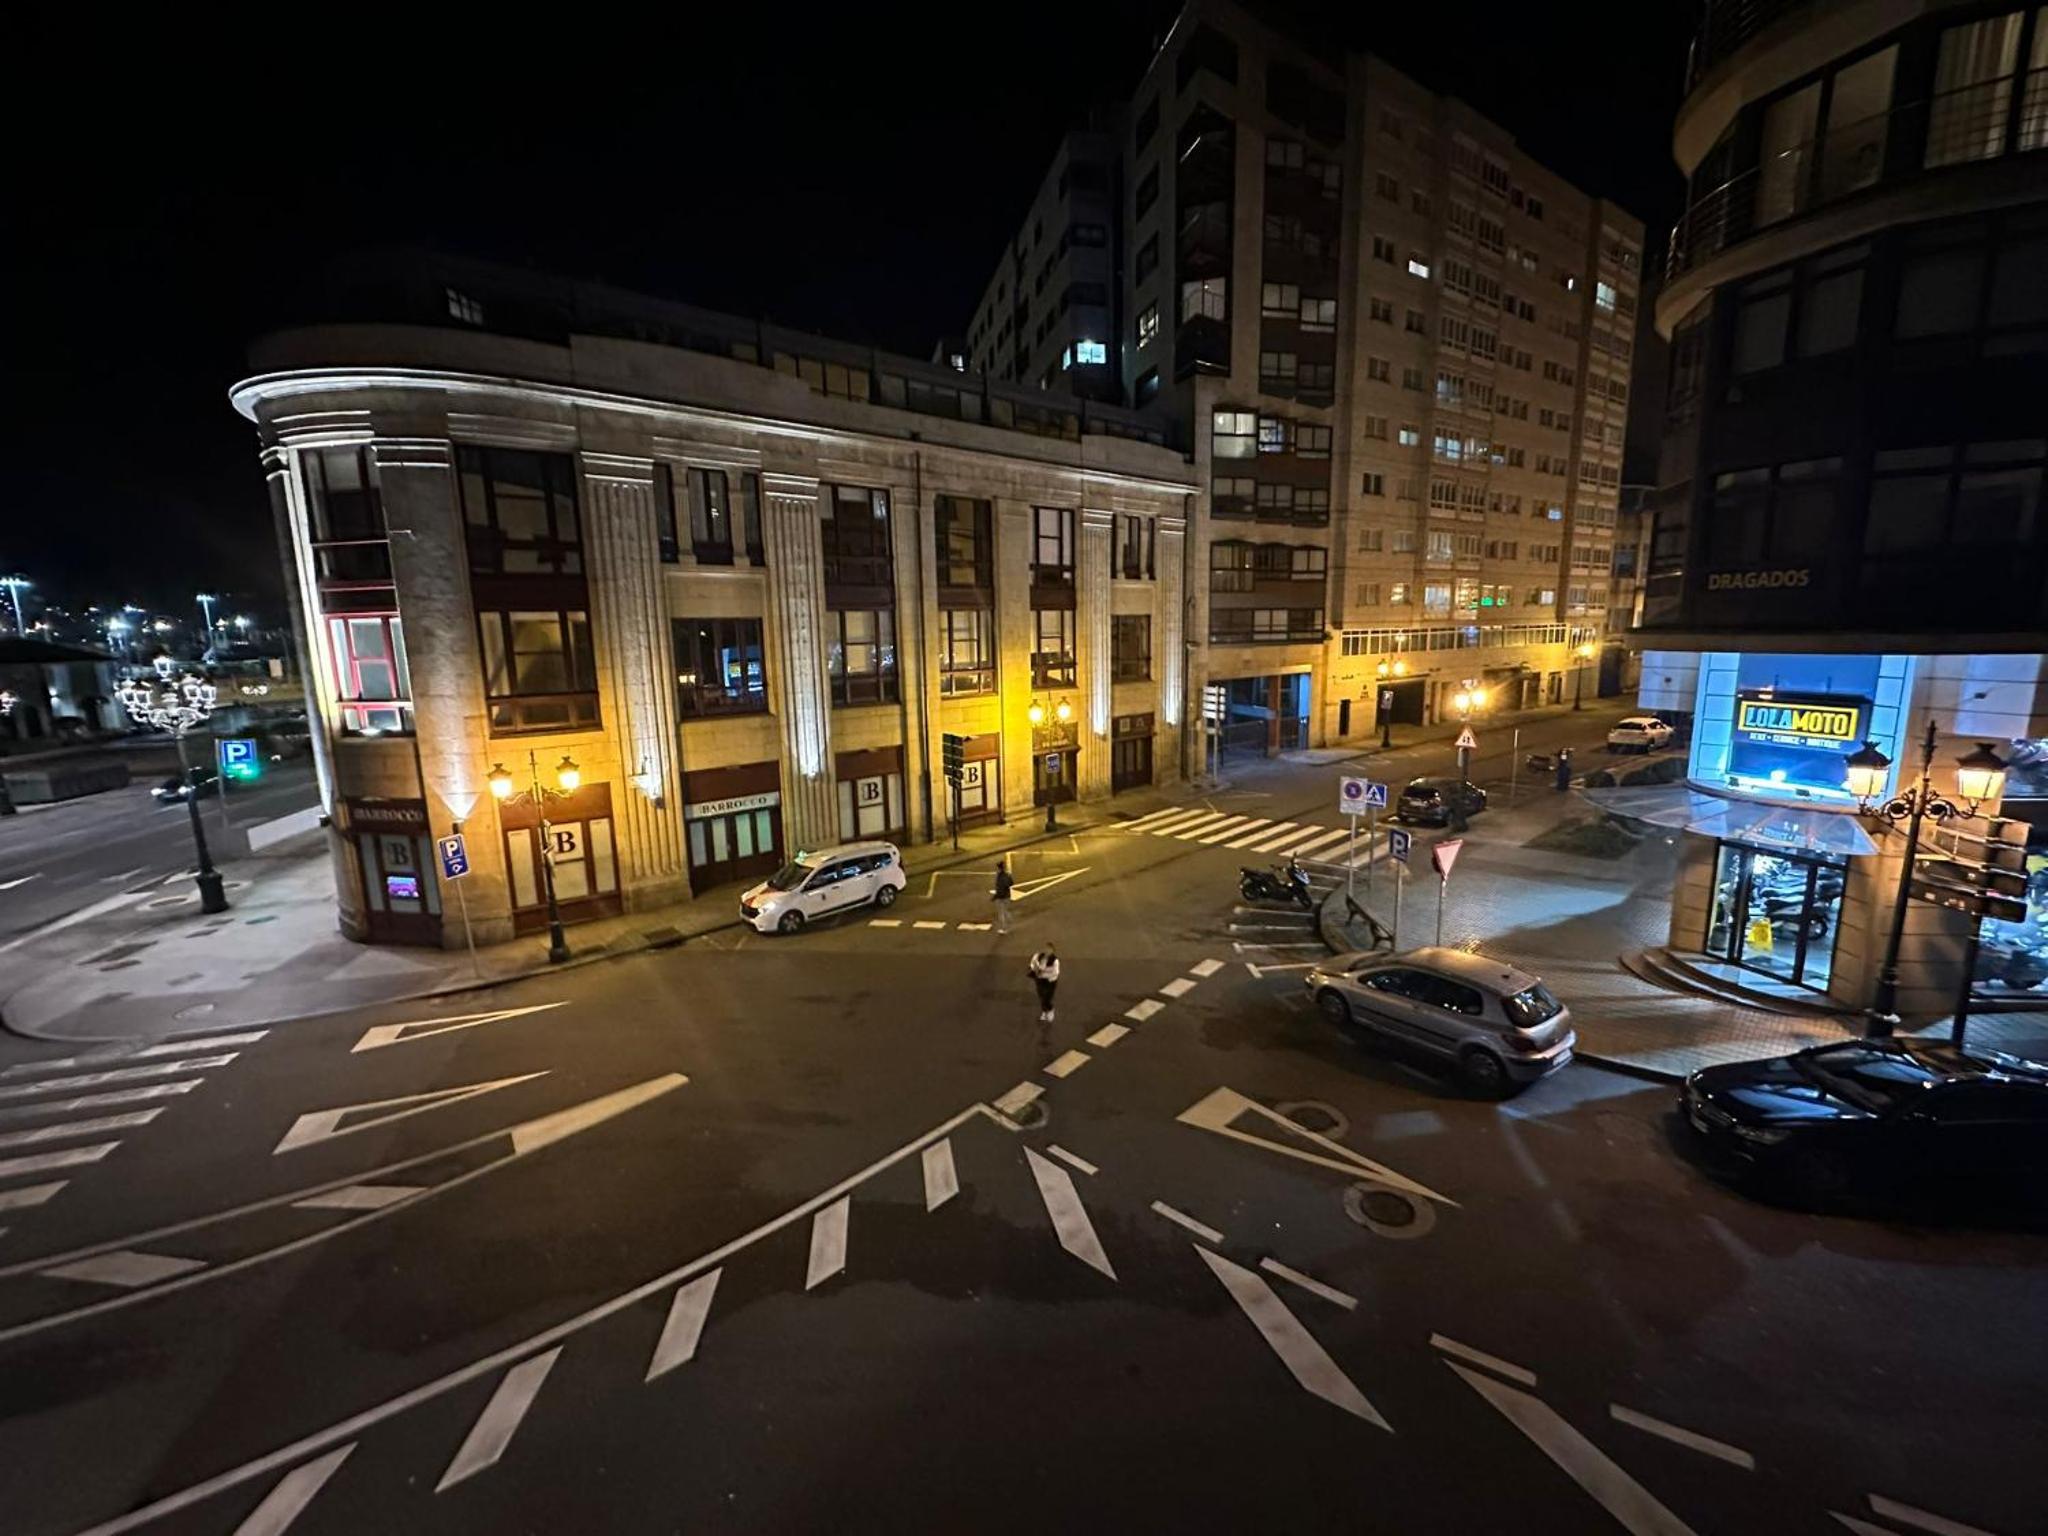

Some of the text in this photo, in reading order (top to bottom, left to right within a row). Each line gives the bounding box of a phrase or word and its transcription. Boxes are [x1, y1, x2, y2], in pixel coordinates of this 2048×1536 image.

[1707, 568, 1810, 591] DRAGADOS
[1745, 706, 1849, 735] LOLAMOTO
[227, 743, 248, 763] P
[967, 766, 979, 783] B
[865, 781, 880, 801] B
[389, 841, 409, 866] B
[444, 840, 459, 858] P
[554, 830, 577, 854] B
[1392, 832, 1407, 857] P
